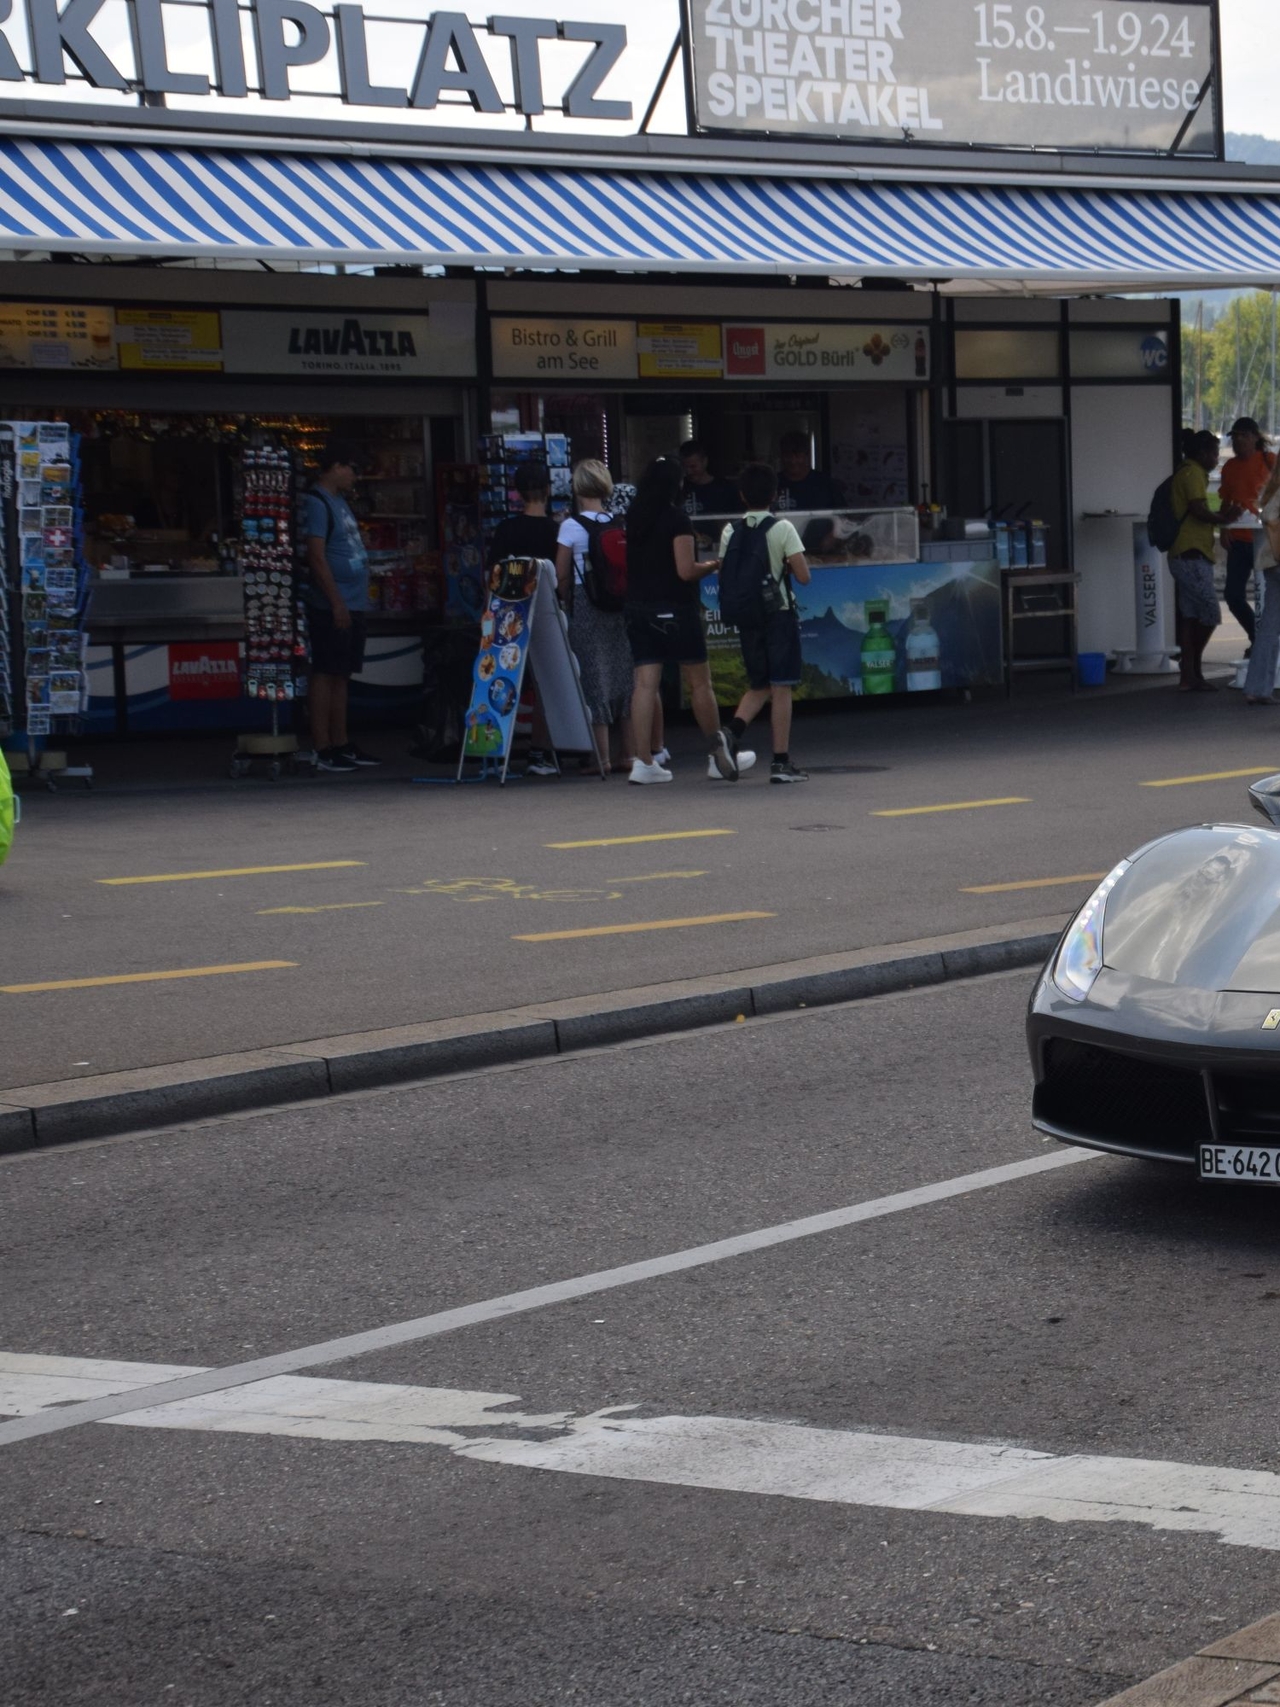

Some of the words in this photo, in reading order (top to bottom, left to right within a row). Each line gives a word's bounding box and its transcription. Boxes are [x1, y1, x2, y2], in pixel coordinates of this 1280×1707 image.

[705, 24, 898, 84] THEATER
[976, 57, 1201, 111] Landiwiese
[707, 71, 944, 130] SPEKTAKEL
[288, 318, 417, 357] LAVAZZA
[512, 328, 561, 347] Bistro
[565, 329, 579, 347] &
[583, 329, 617, 347] Grill
[537, 356, 564, 369] am
[568, 352, 599, 370] See
[774, 350, 817, 366] GOLD
[1140, 349, 1168, 367] WC
[1143, 573, 1157, 628] VALSER
[172, 655, 239, 676] LAVAZZA
